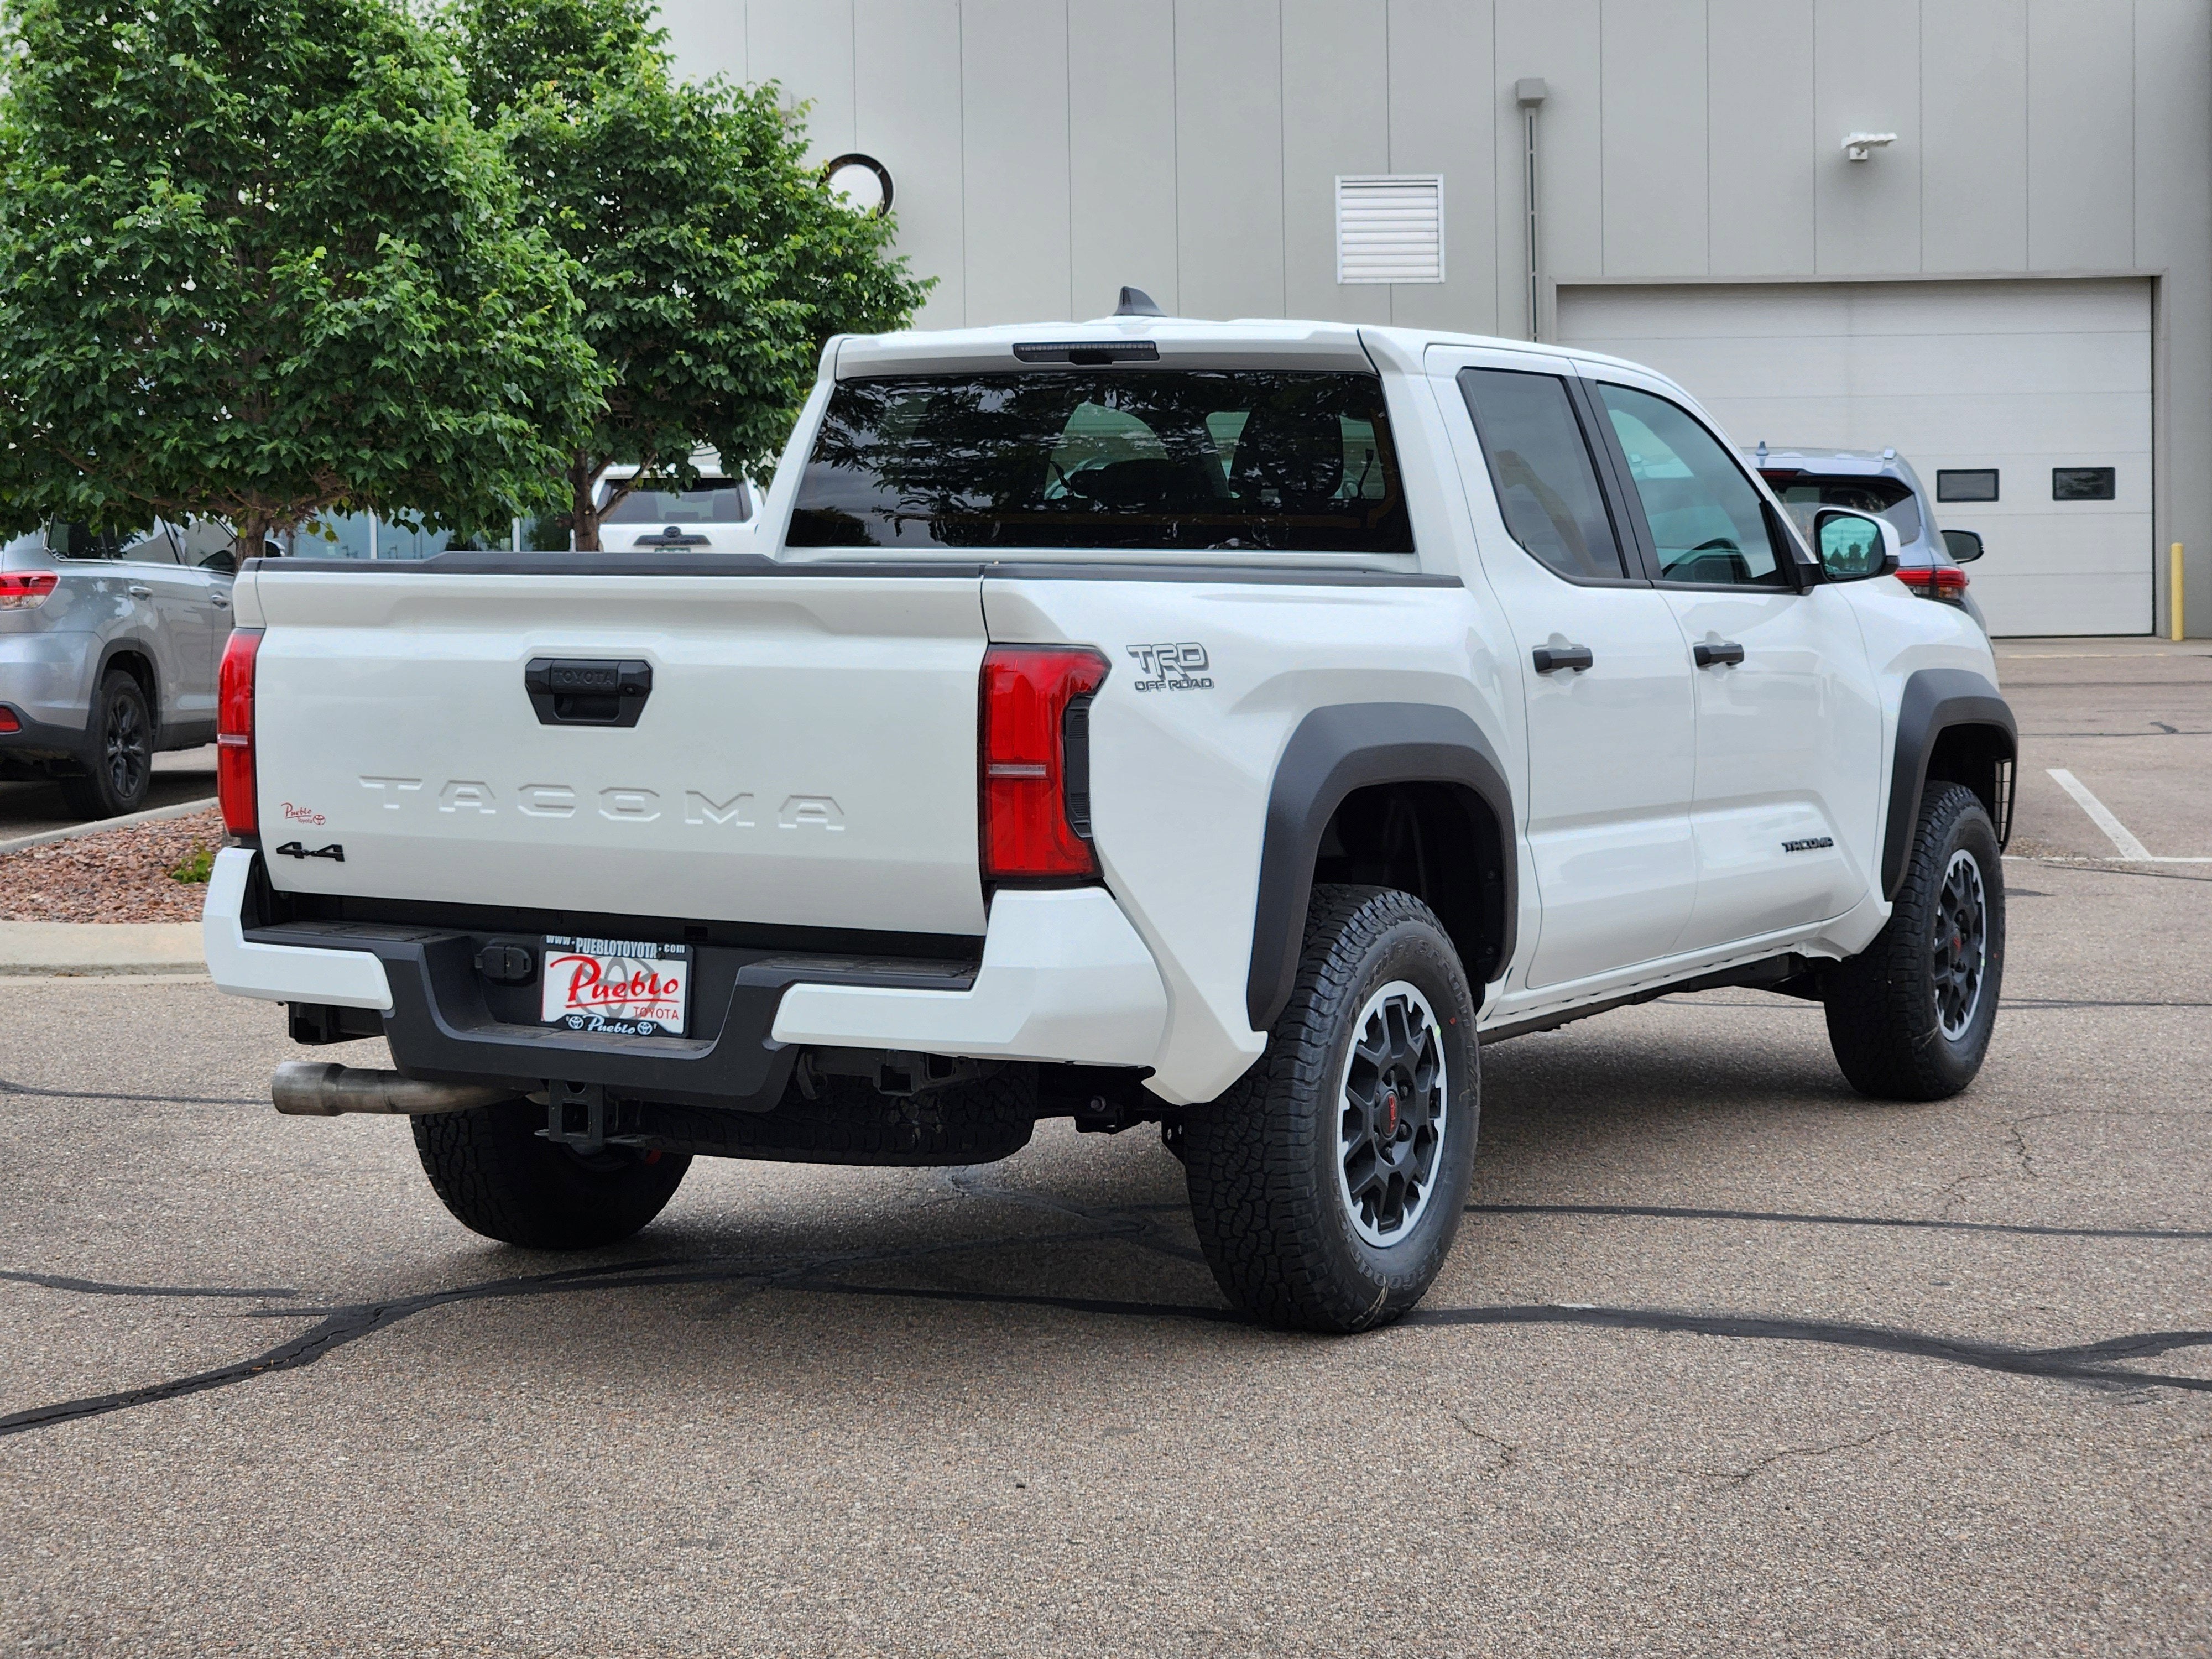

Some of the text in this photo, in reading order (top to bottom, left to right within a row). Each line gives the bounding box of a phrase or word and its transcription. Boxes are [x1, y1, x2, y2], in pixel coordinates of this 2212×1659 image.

[1126, 642, 1209, 680] TRD
[554, 670, 613, 685] TOYOTA
[1135, 678, 1214, 692] OFF ROAD
[281, 802, 312, 817] Pueblo
[358, 775, 846, 832] TACOMA
[550, 955, 679, 1002] Pueblo
[633, 1006, 679, 1020] TOYOTA
[582, 1014, 635, 1034] Pueblo
